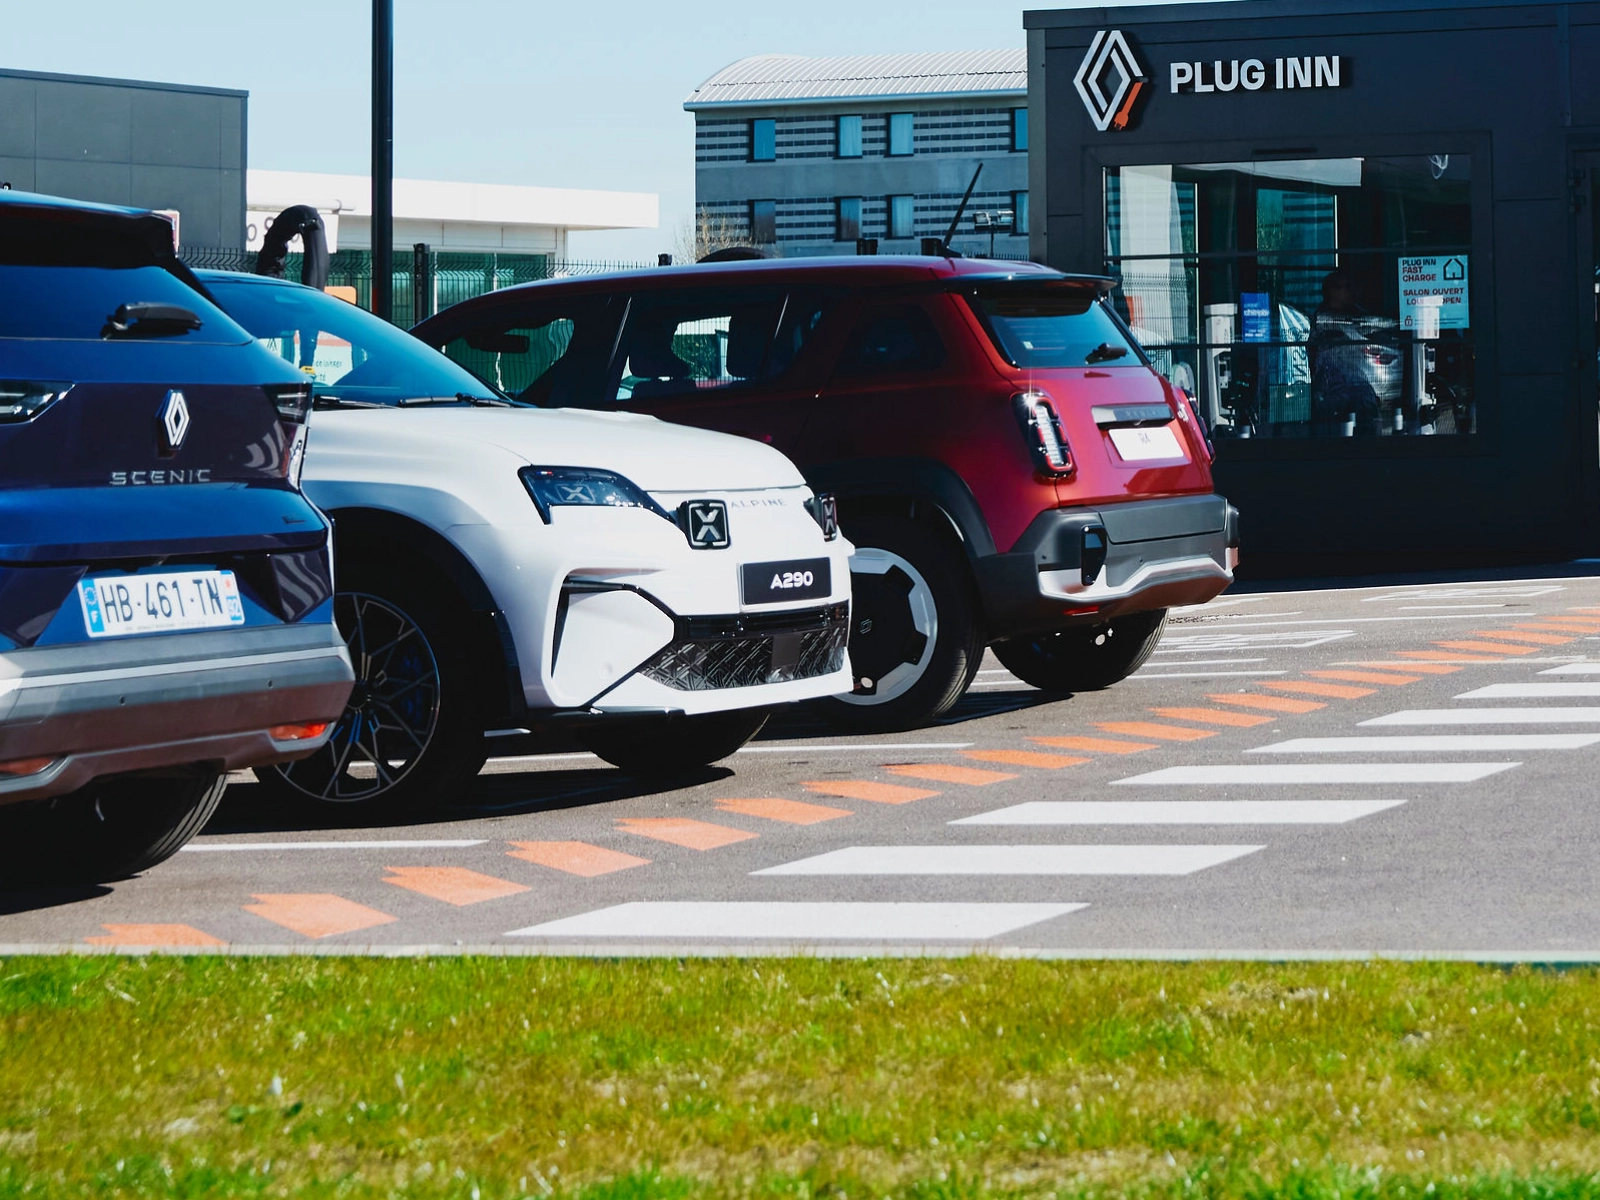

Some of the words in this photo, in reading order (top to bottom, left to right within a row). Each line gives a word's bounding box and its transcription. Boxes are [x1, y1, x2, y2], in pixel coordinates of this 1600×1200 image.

[1170, 58, 1266, 94] PLUG
[1275, 55, 1340, 90] INN
[1402, 259, 1422, 267] PLUG
[1423, 258, 1437, 266] INN
[1402, 266, 1423, 274] FAST
[1402, 274, 1437, 282] CHARGE
[110, 469, 211, 485] SCENIC
[731, 498, 788, 509] ALPINE
[770, 571, 814, 590] A290
